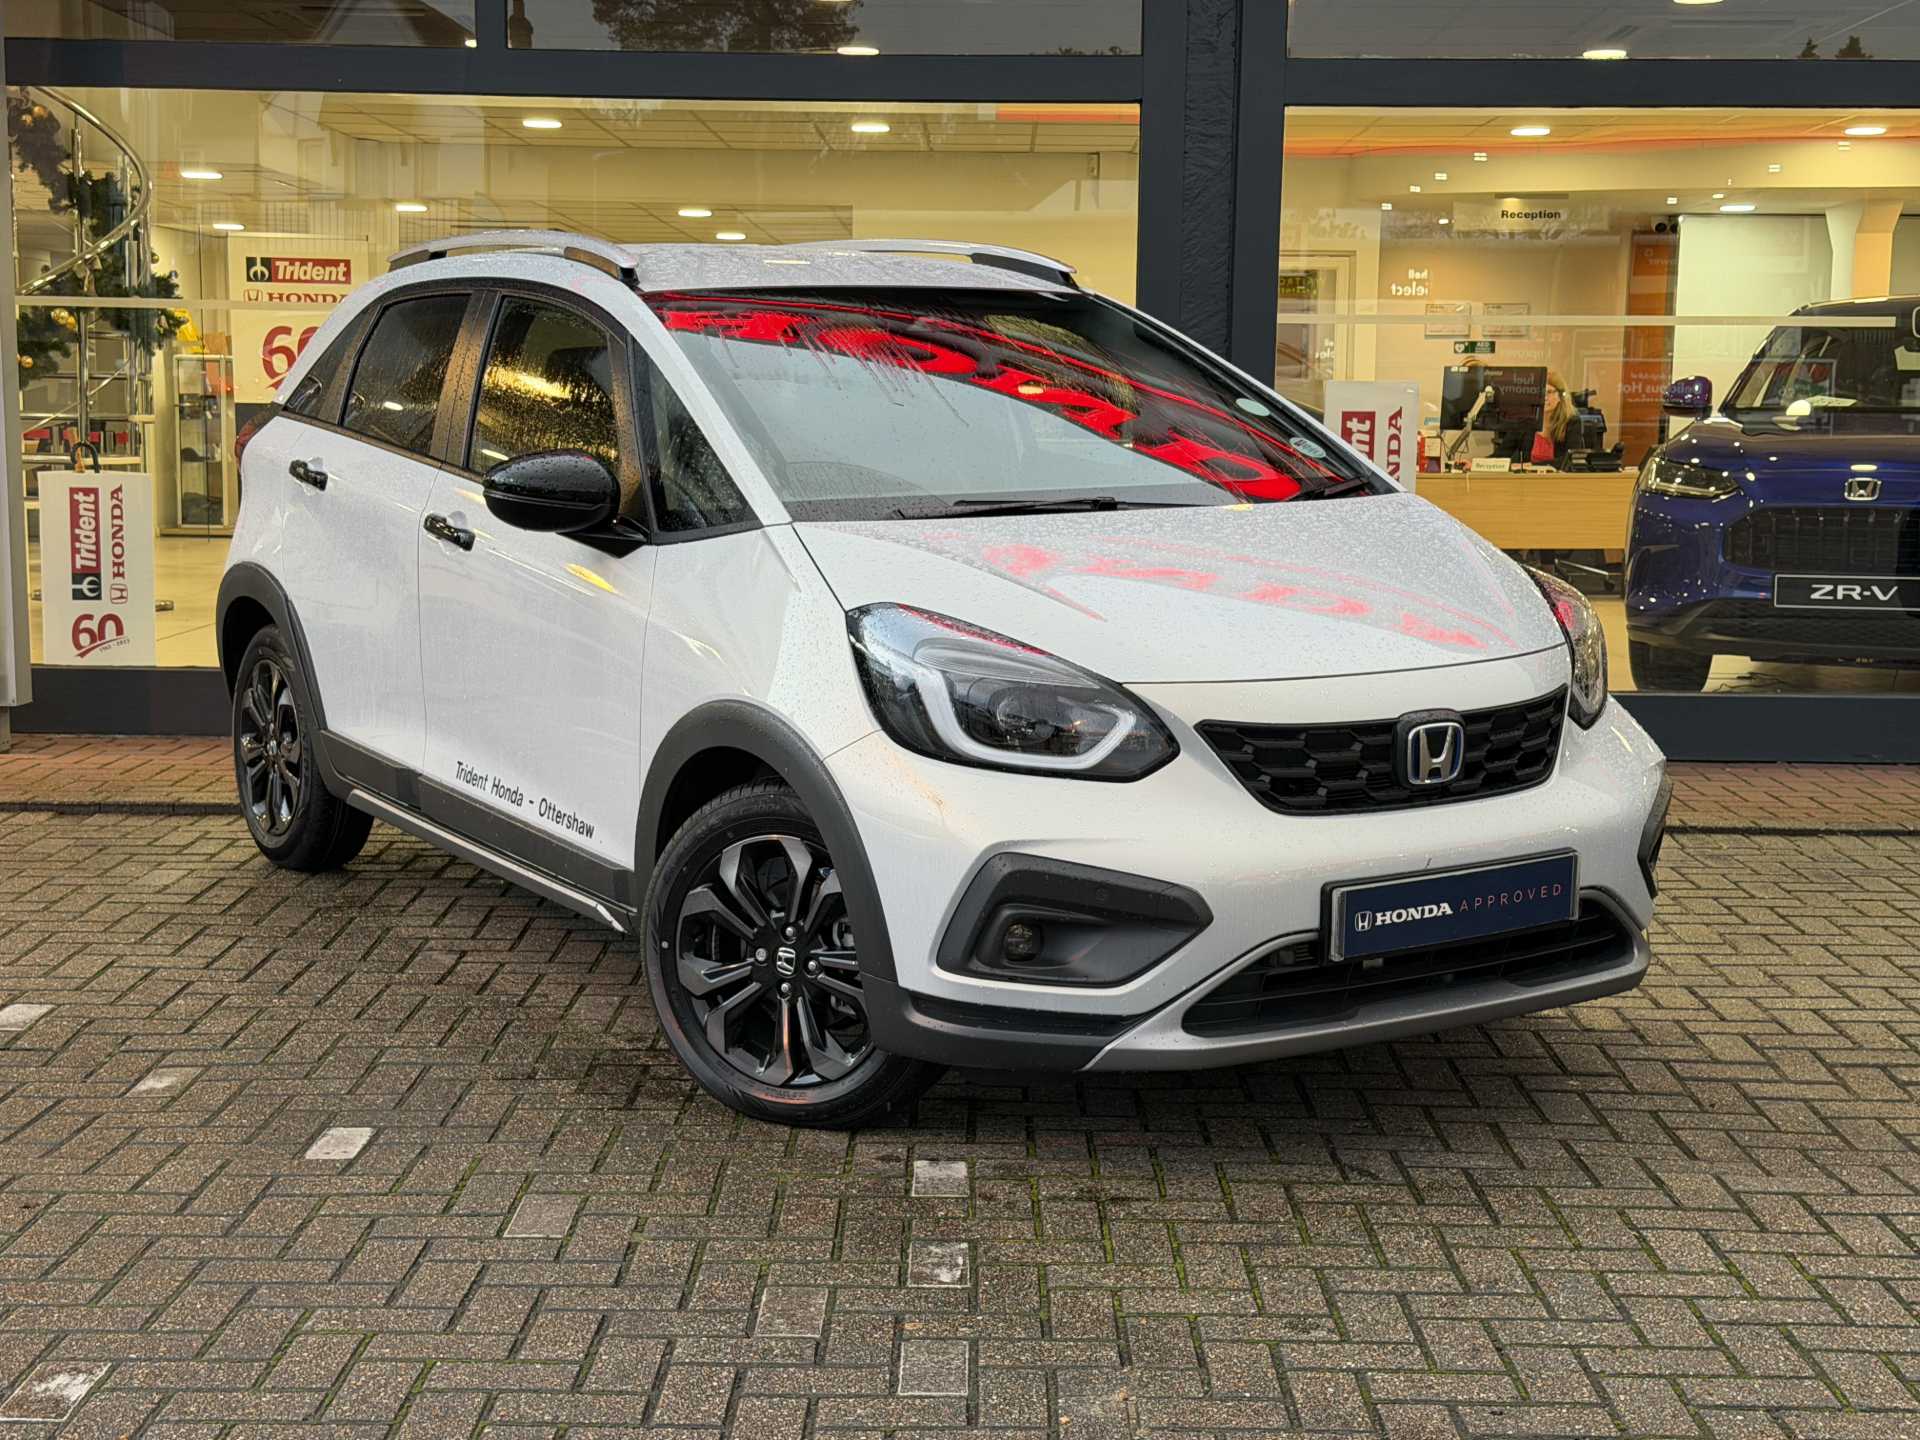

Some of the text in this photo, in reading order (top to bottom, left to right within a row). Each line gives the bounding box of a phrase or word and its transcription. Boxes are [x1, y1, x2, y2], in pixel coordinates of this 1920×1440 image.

[1500, 209, 1561, 221] Reception
[275, 260, 348, 282] Trident
[73, 491, 97, 570] Trident
[110, 484, 126, 579] HONDA
[1809, 583, 1899, 601] ZR-V
[71, 613, 125, 652] 60
[455, 760, 489, 791] Trident
[490, 775, 524, 807] Honda
[538, 797, 596, 839] Ottershaw
[1374, 883, 1564, 927] HONDA APPROVED
